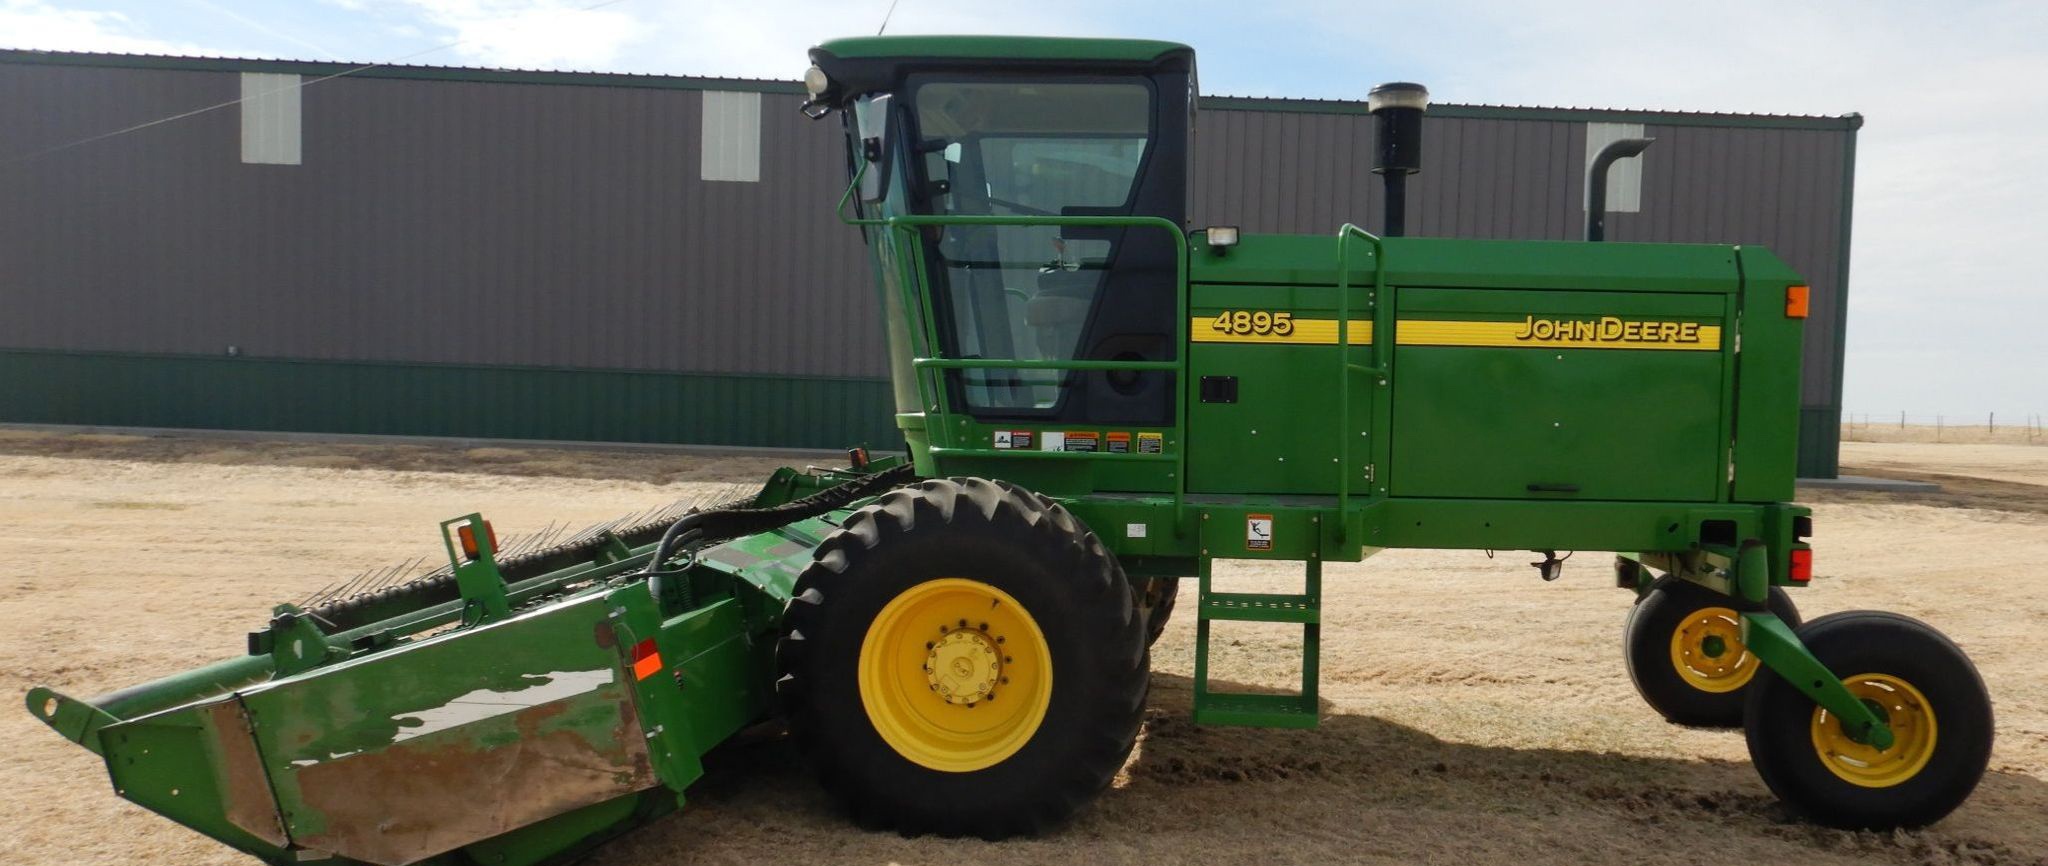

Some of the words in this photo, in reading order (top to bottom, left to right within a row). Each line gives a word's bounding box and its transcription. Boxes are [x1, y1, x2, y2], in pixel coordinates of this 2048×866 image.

[1213, 310, 1294, 336] 4895
[1516, 315, 1596, 341] JOHN
[1601, 316, 1700, 342] DEERE
